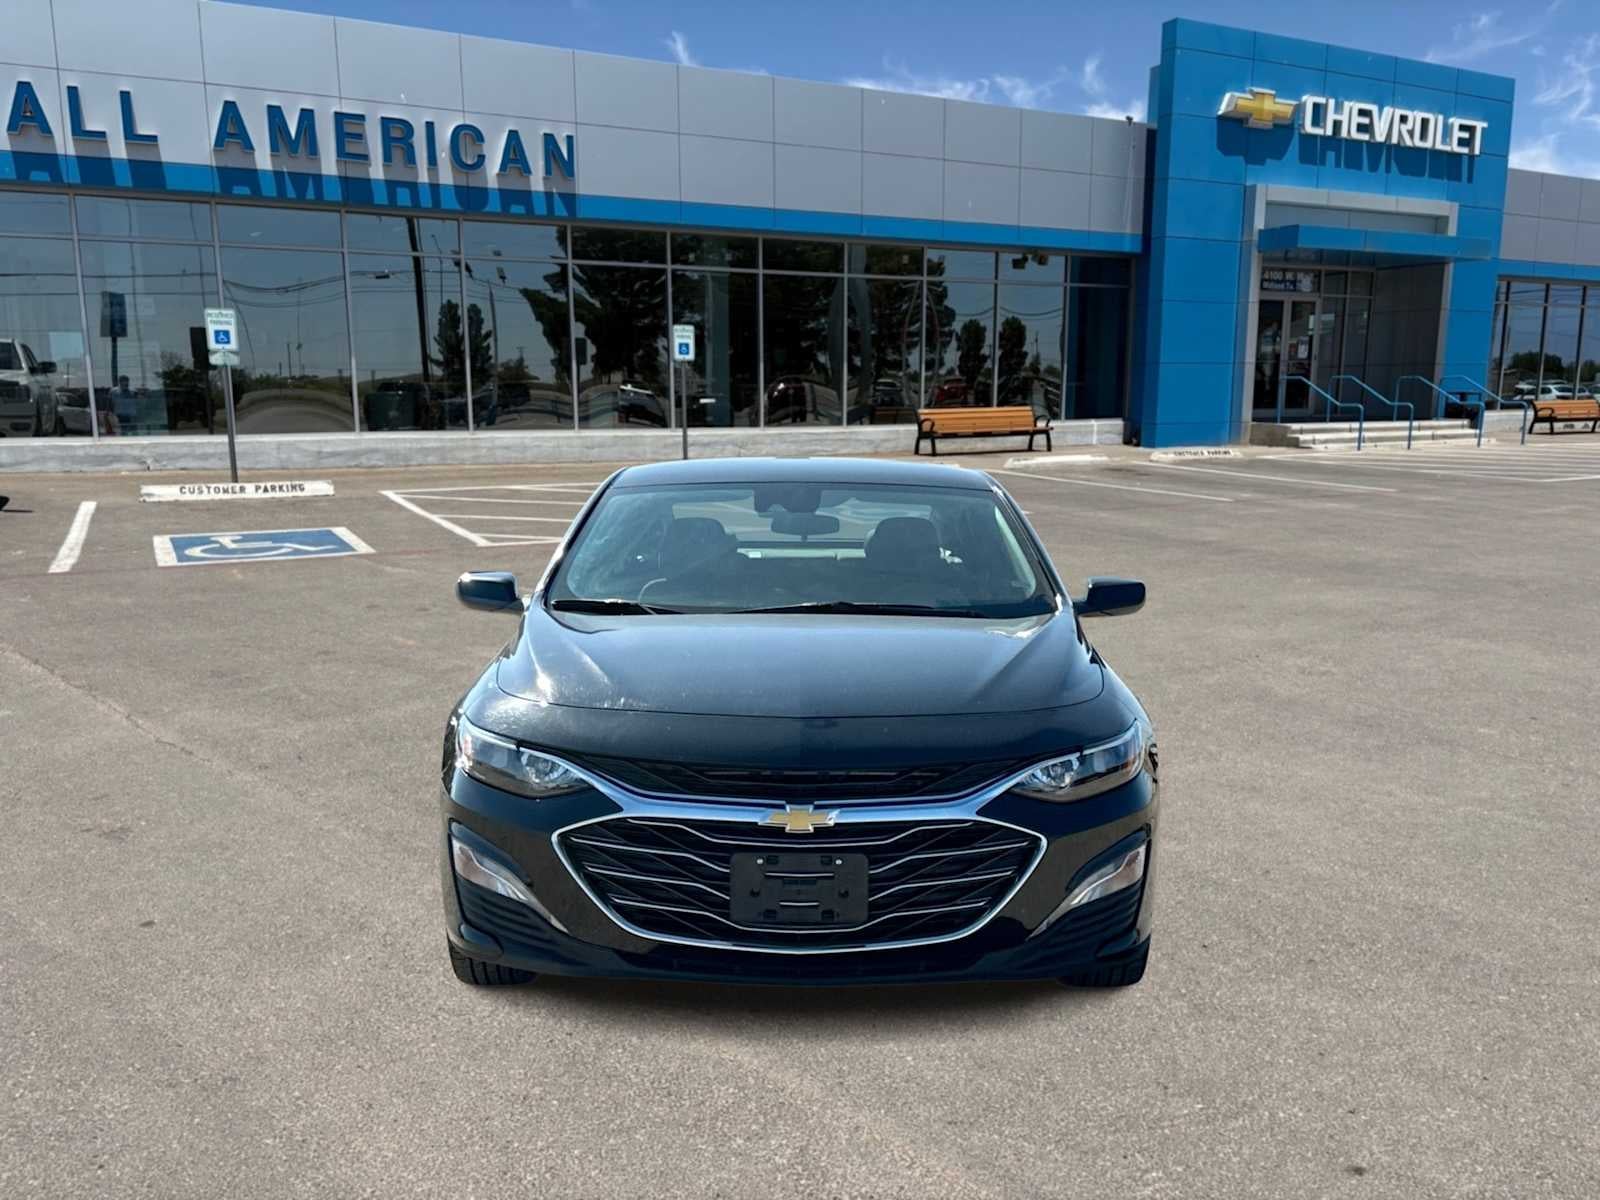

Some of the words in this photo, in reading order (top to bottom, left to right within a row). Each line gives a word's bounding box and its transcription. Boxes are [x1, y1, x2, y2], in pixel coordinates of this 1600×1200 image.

[7, 81, 158, 144] ALL
[213, 100, 575, 179] AMERICAN
[1301, 94, 1488, 155] CHEVROLET
[179, 485, 246, 495] CUSTOMER
[255, 483, 305, 493] PARKING
